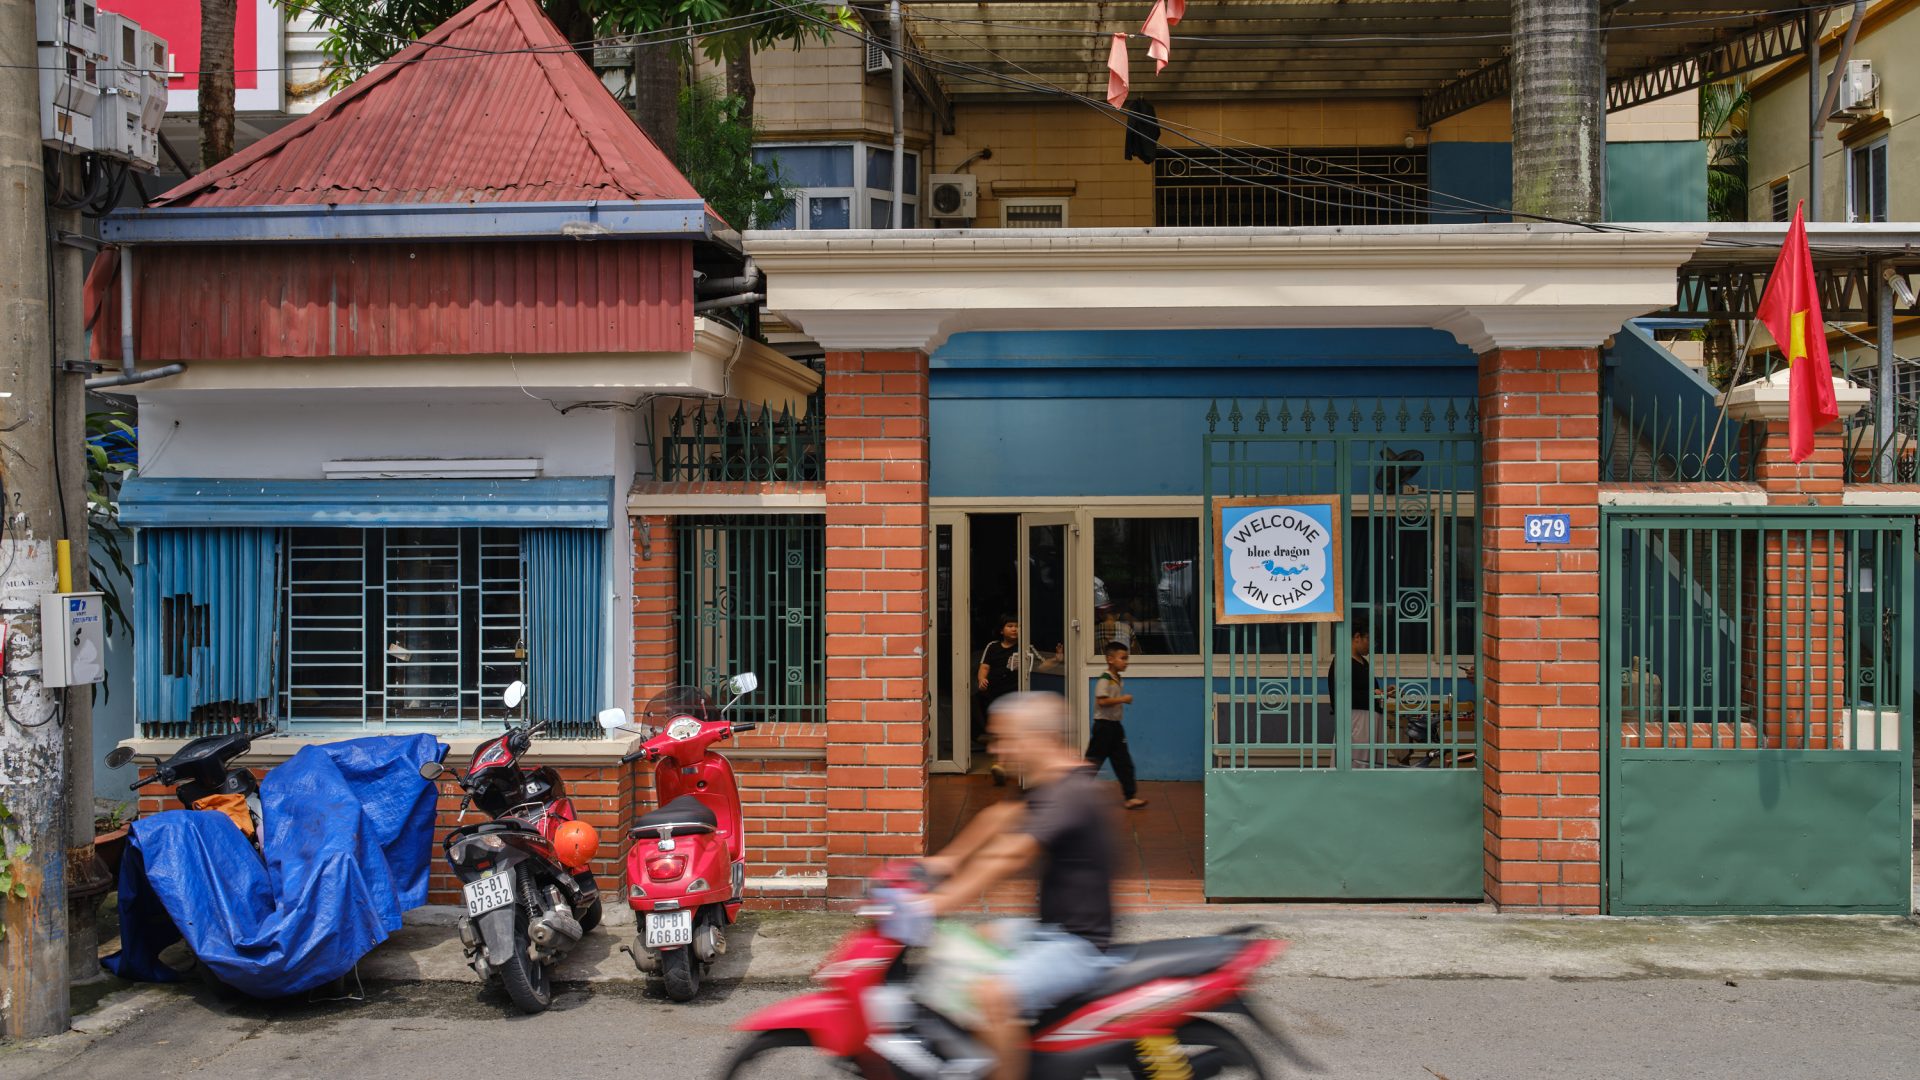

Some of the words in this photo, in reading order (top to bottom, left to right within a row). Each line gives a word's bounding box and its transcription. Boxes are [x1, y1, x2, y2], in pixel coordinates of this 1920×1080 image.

[1234, 514, 1320, 544] WELCOME
[1529, 518, 1566, 538] 879
[1247, 547, 1271, 557] blue
[1273, 546, 1310, 561] dragon
[1243, 581, 1269, 604] XIN
[1272, 579, 1313, 607] CHÀO
[471, 876, 503, 898] 15-B1
[470, 888, 511, 914] 973.52
[652, 913, 684, 930] 90-B1
[649, 928, 689, 945] 466.88
